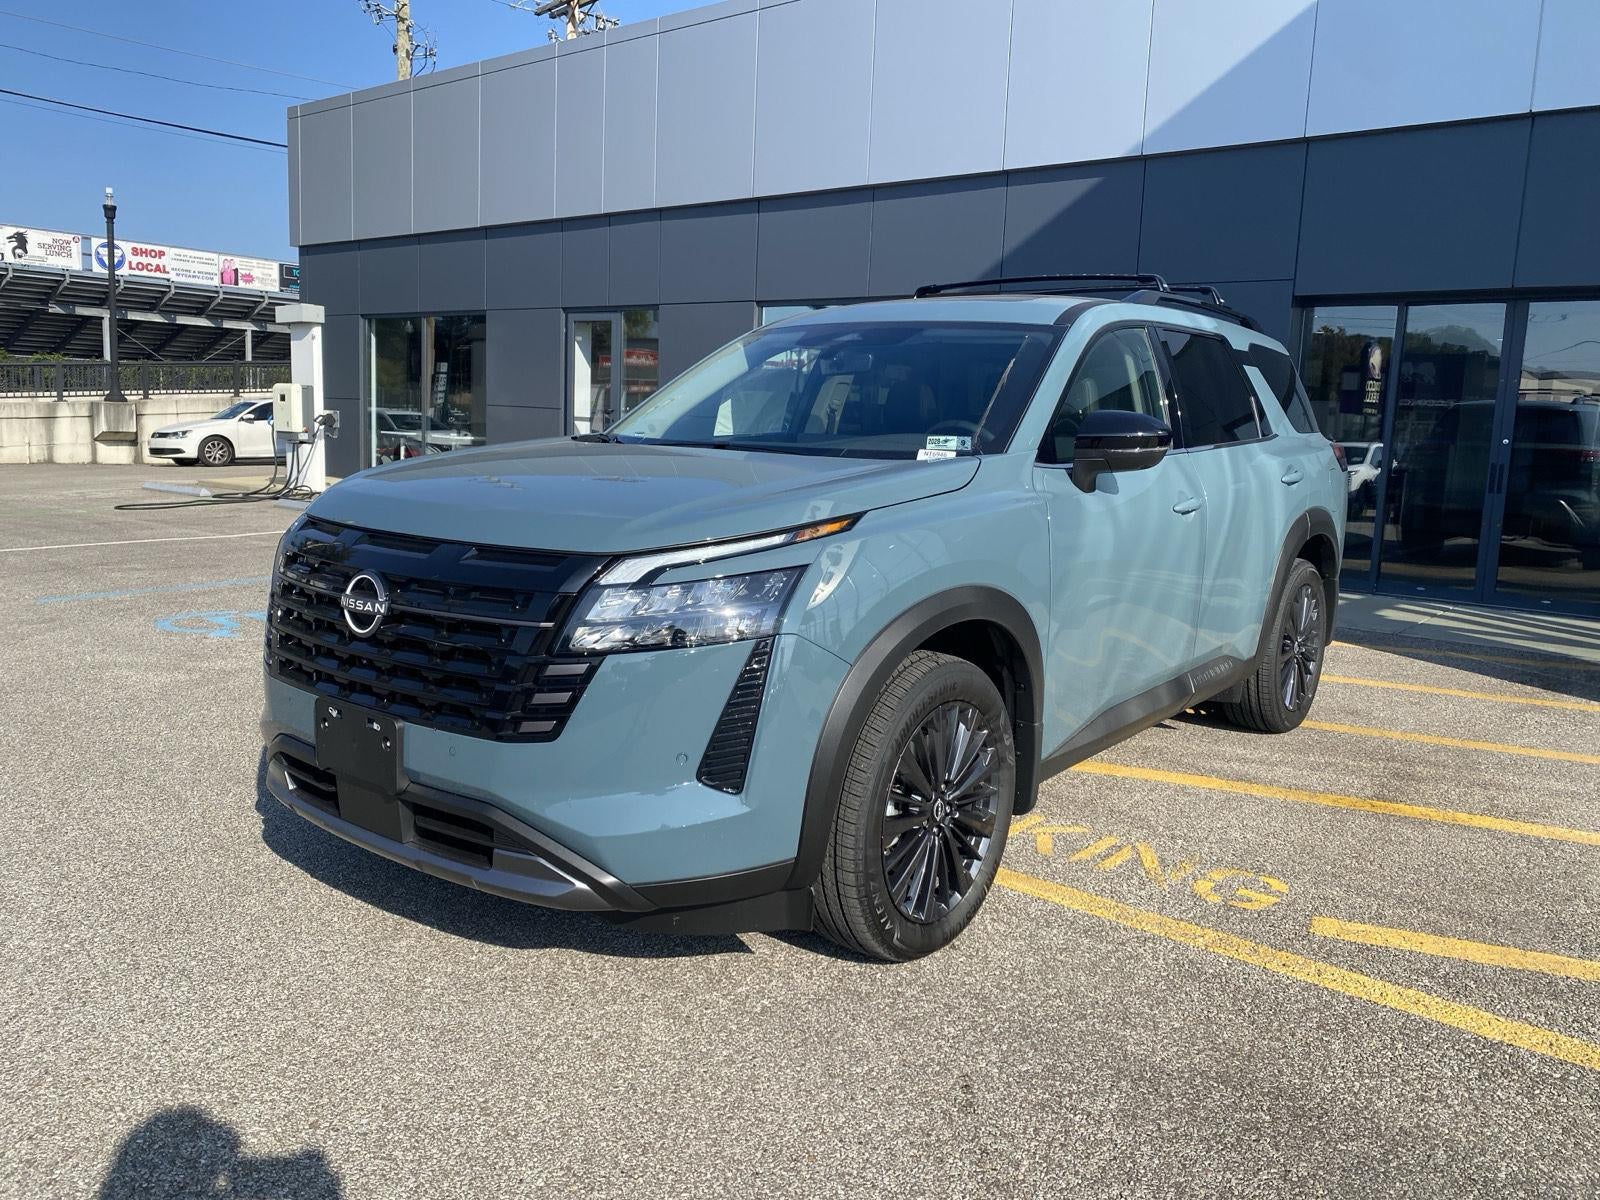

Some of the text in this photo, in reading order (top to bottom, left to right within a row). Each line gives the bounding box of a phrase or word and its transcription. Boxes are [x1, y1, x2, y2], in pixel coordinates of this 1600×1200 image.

[37, 242, 72, 252] SERVING
[52, 238, 72, 246] NOW
[45, 249, 73, 259] LUNCH
[131, 246, 166, 260] SHOP
[128, 260, 170, 274] LOCAL
[341, 595, 385, 614] NISSAN
